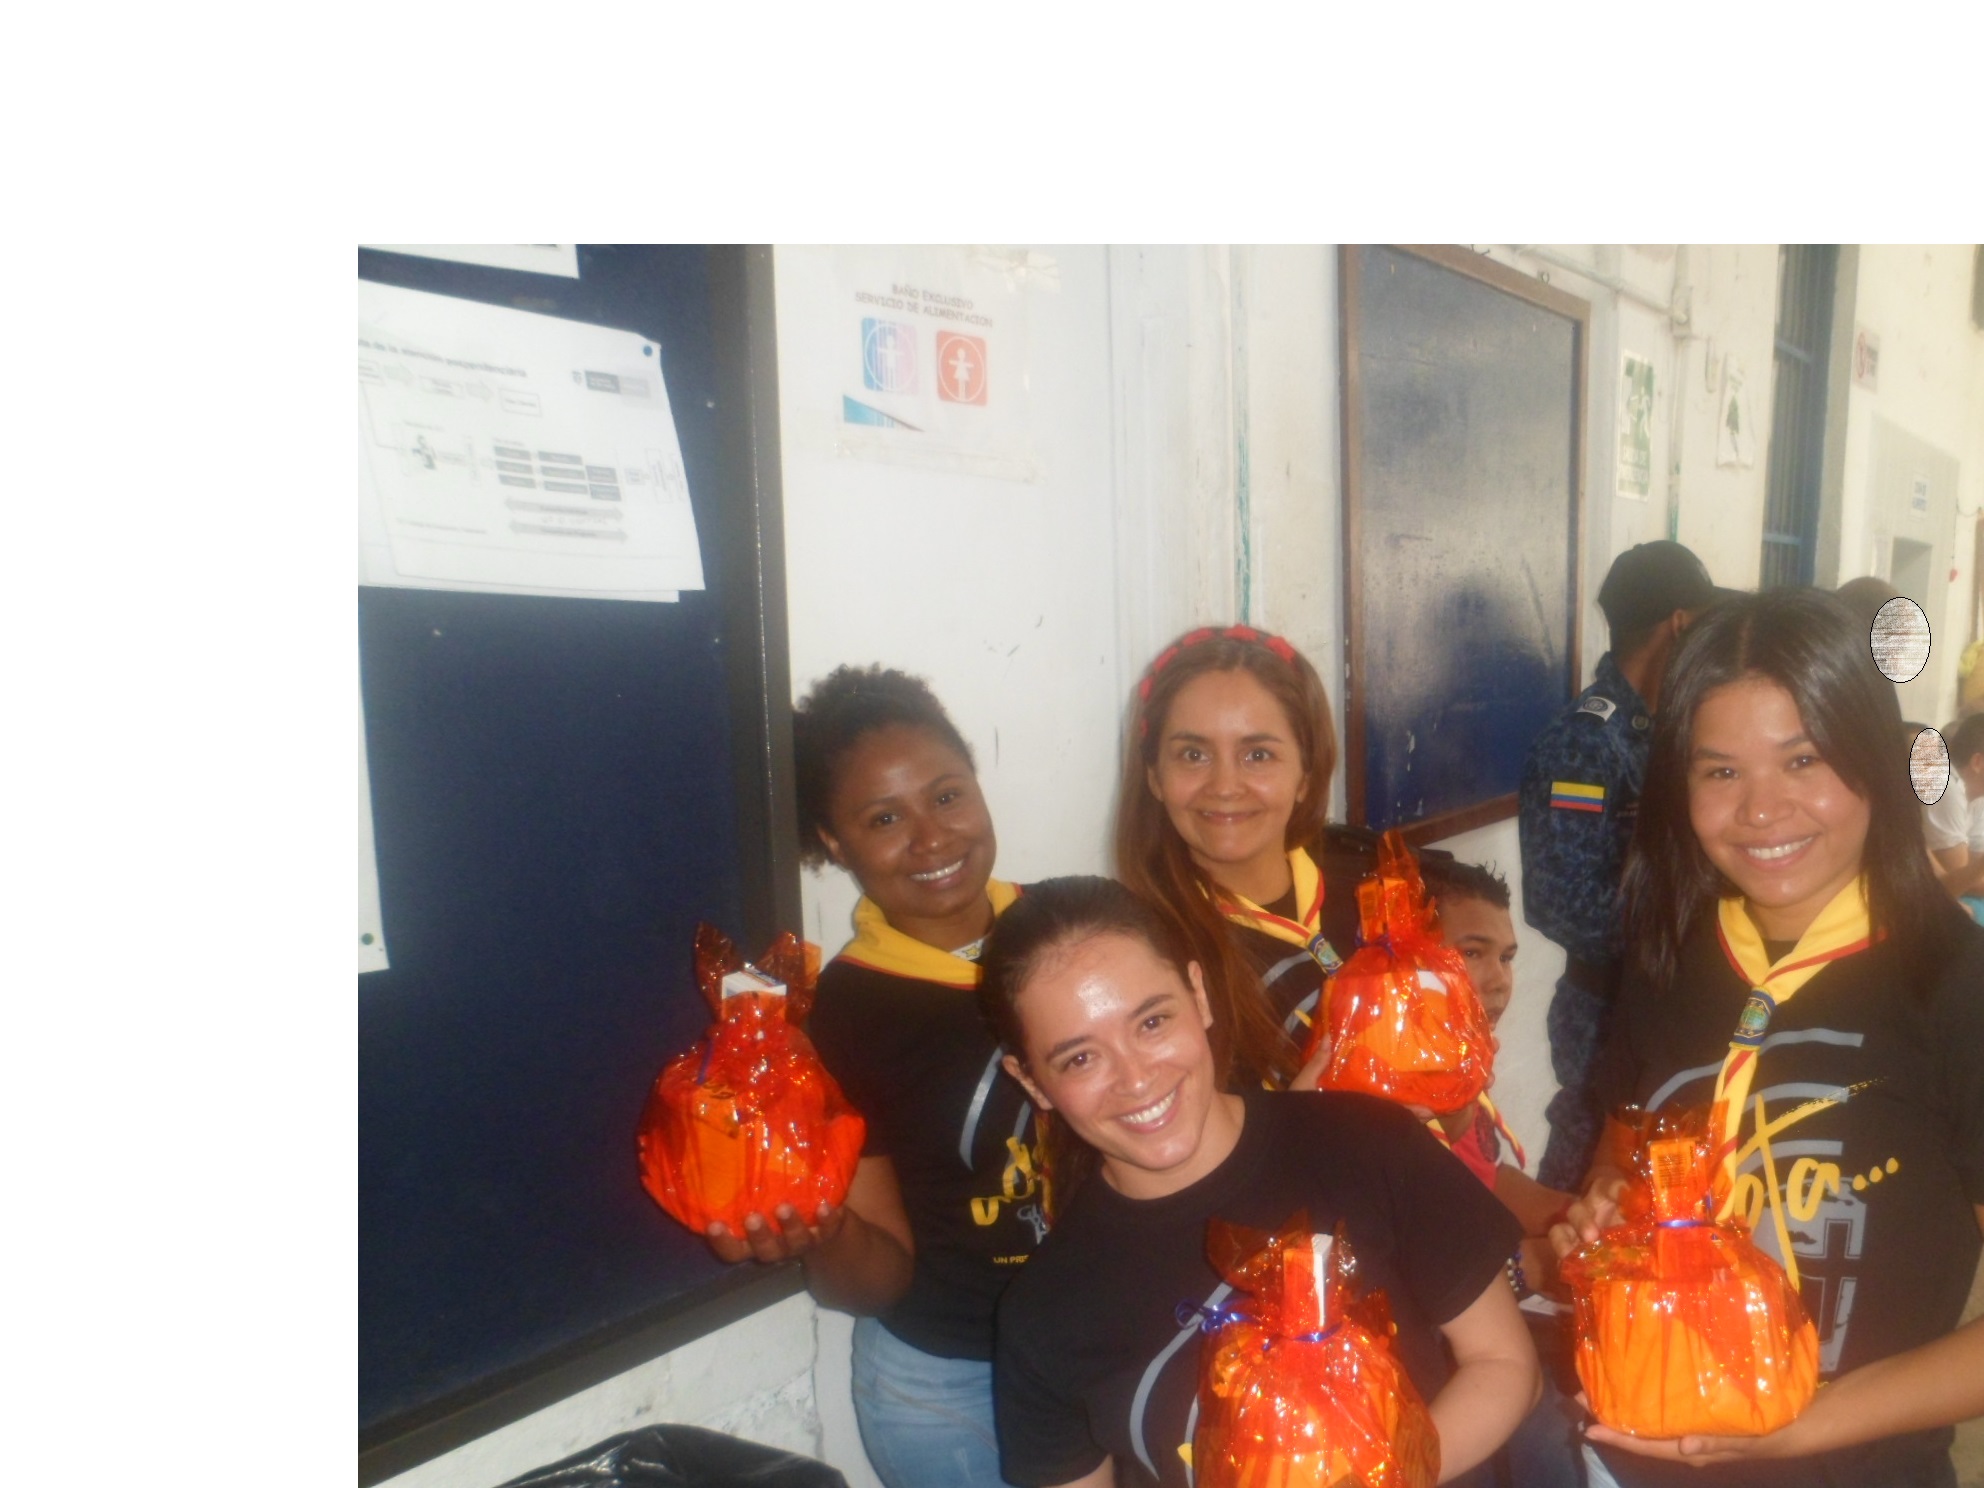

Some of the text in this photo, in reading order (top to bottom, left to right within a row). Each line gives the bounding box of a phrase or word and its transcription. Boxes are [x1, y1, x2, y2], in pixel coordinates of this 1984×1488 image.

[854, 291, 904, 311] SERVICIO
[906, 301, 920, 314] DE
[891, 283, 974, 310] BAÑO EXCLUSIVO
